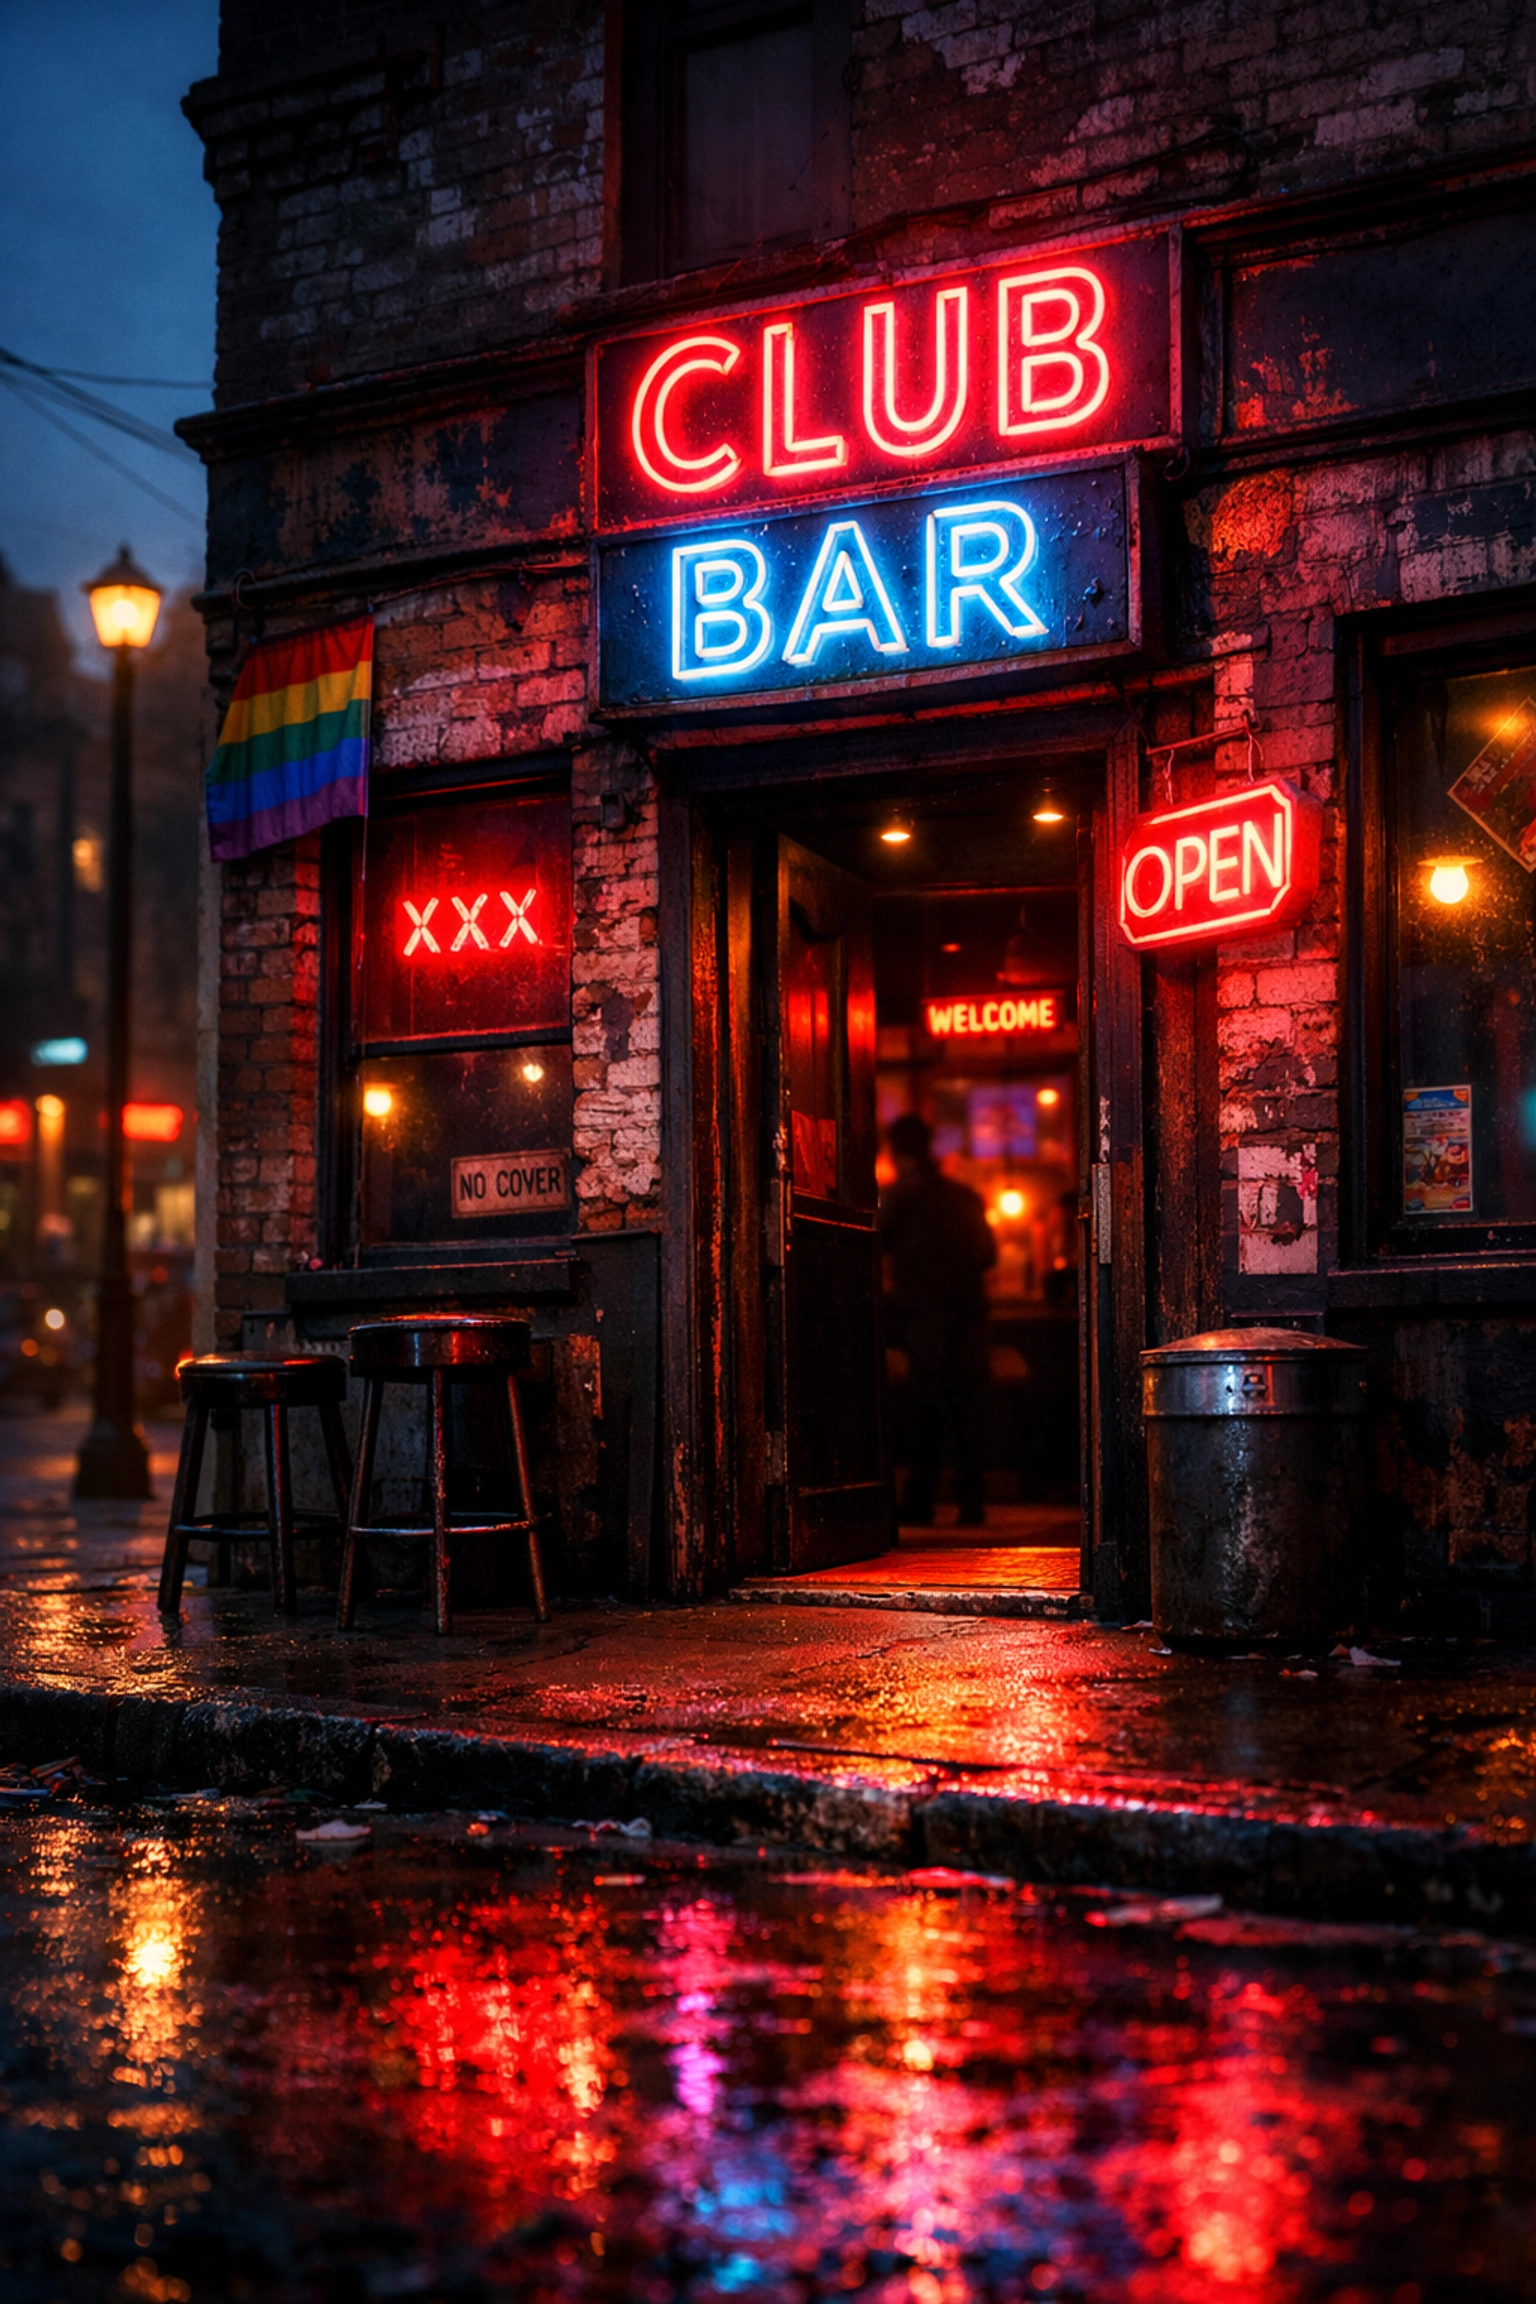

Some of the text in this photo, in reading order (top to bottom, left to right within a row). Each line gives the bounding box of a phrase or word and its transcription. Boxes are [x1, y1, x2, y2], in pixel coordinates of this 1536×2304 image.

[632, 266, 1110, 493] CLUB
[671, 500, 1049, 681] BAR
[1125, 812, 1283, 918] OPEN
[403, 888, 539, 957] XXX
[928, 997, 1055, 1034] WELCOME
[459, 1166, 562, 1201] NO COVER
